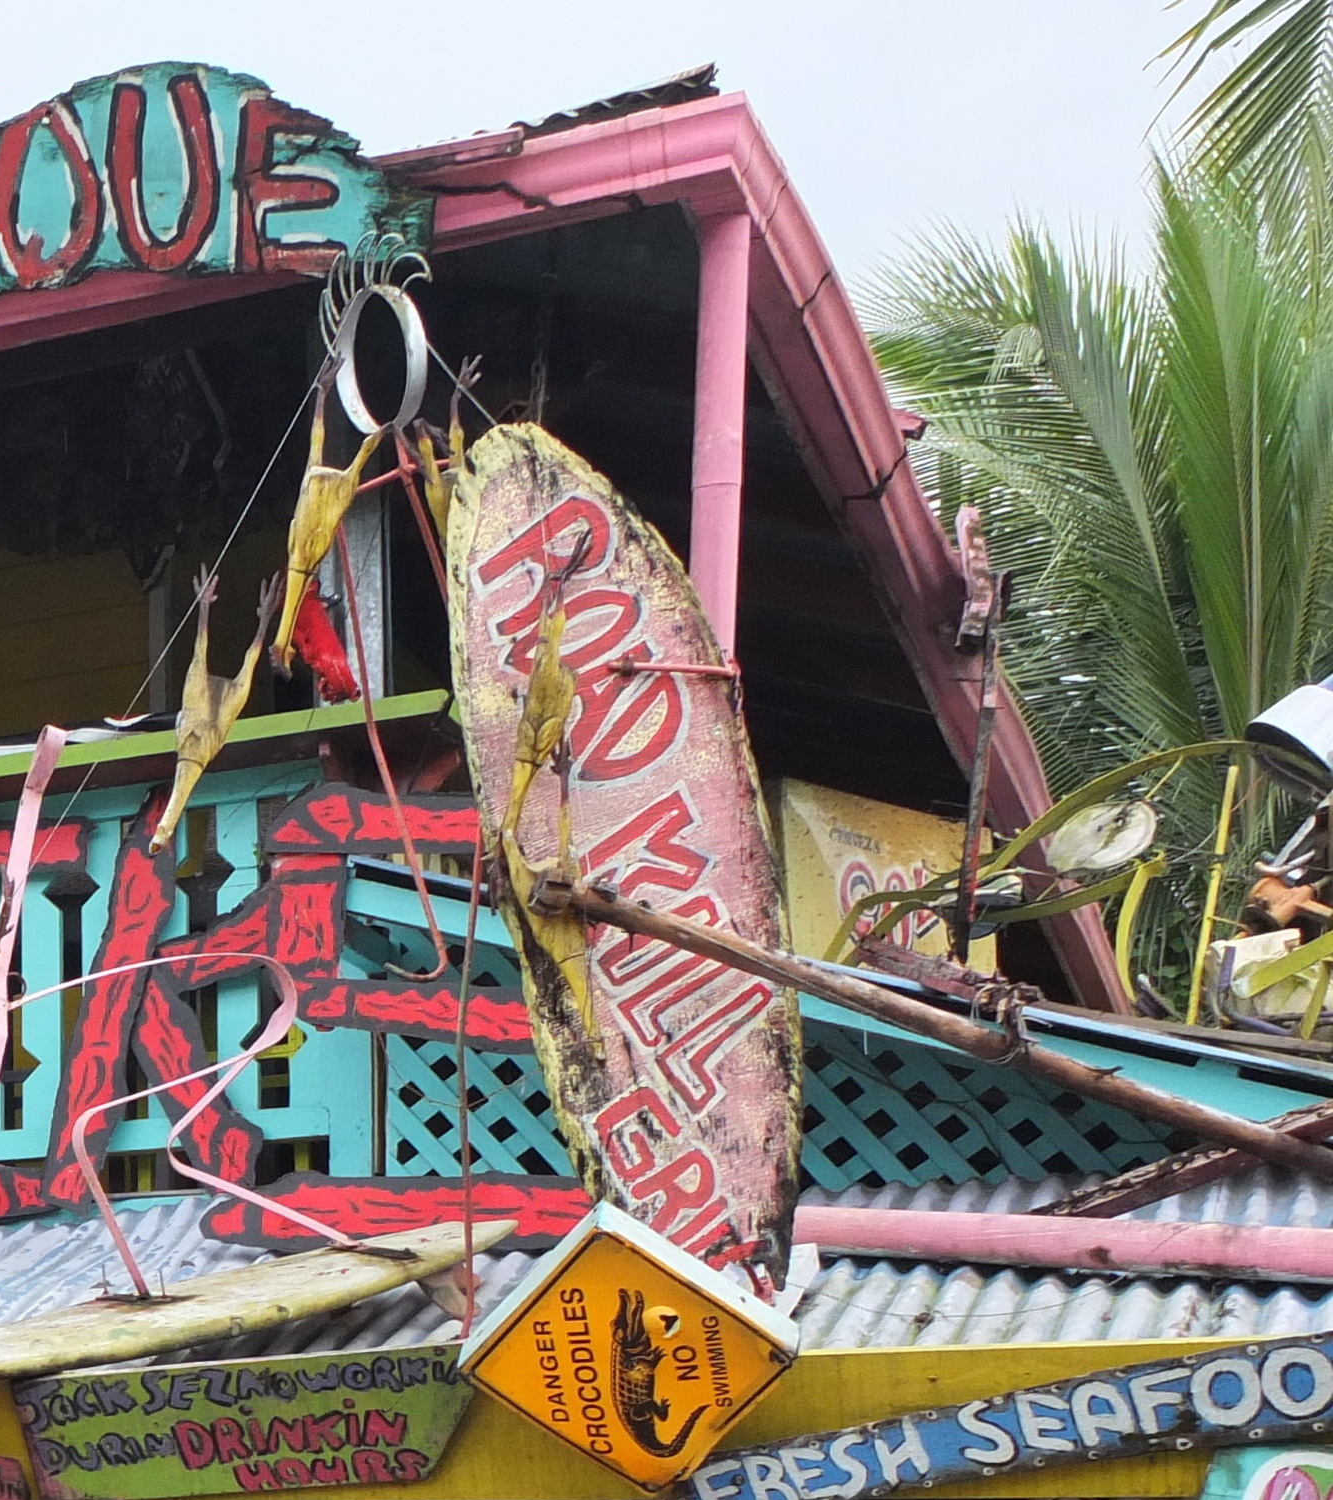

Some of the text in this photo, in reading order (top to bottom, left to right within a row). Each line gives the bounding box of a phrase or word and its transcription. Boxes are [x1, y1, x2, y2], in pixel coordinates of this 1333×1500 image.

[532, 1319, 571, 1423] DANGER
[560, 1287, 614, 1455] CROCODILES
[671, 1345, 701, 1383] NO
[701, 1314, 733, 1409] SWIMMING
[233, 1447, 431, 1492] HOURS
